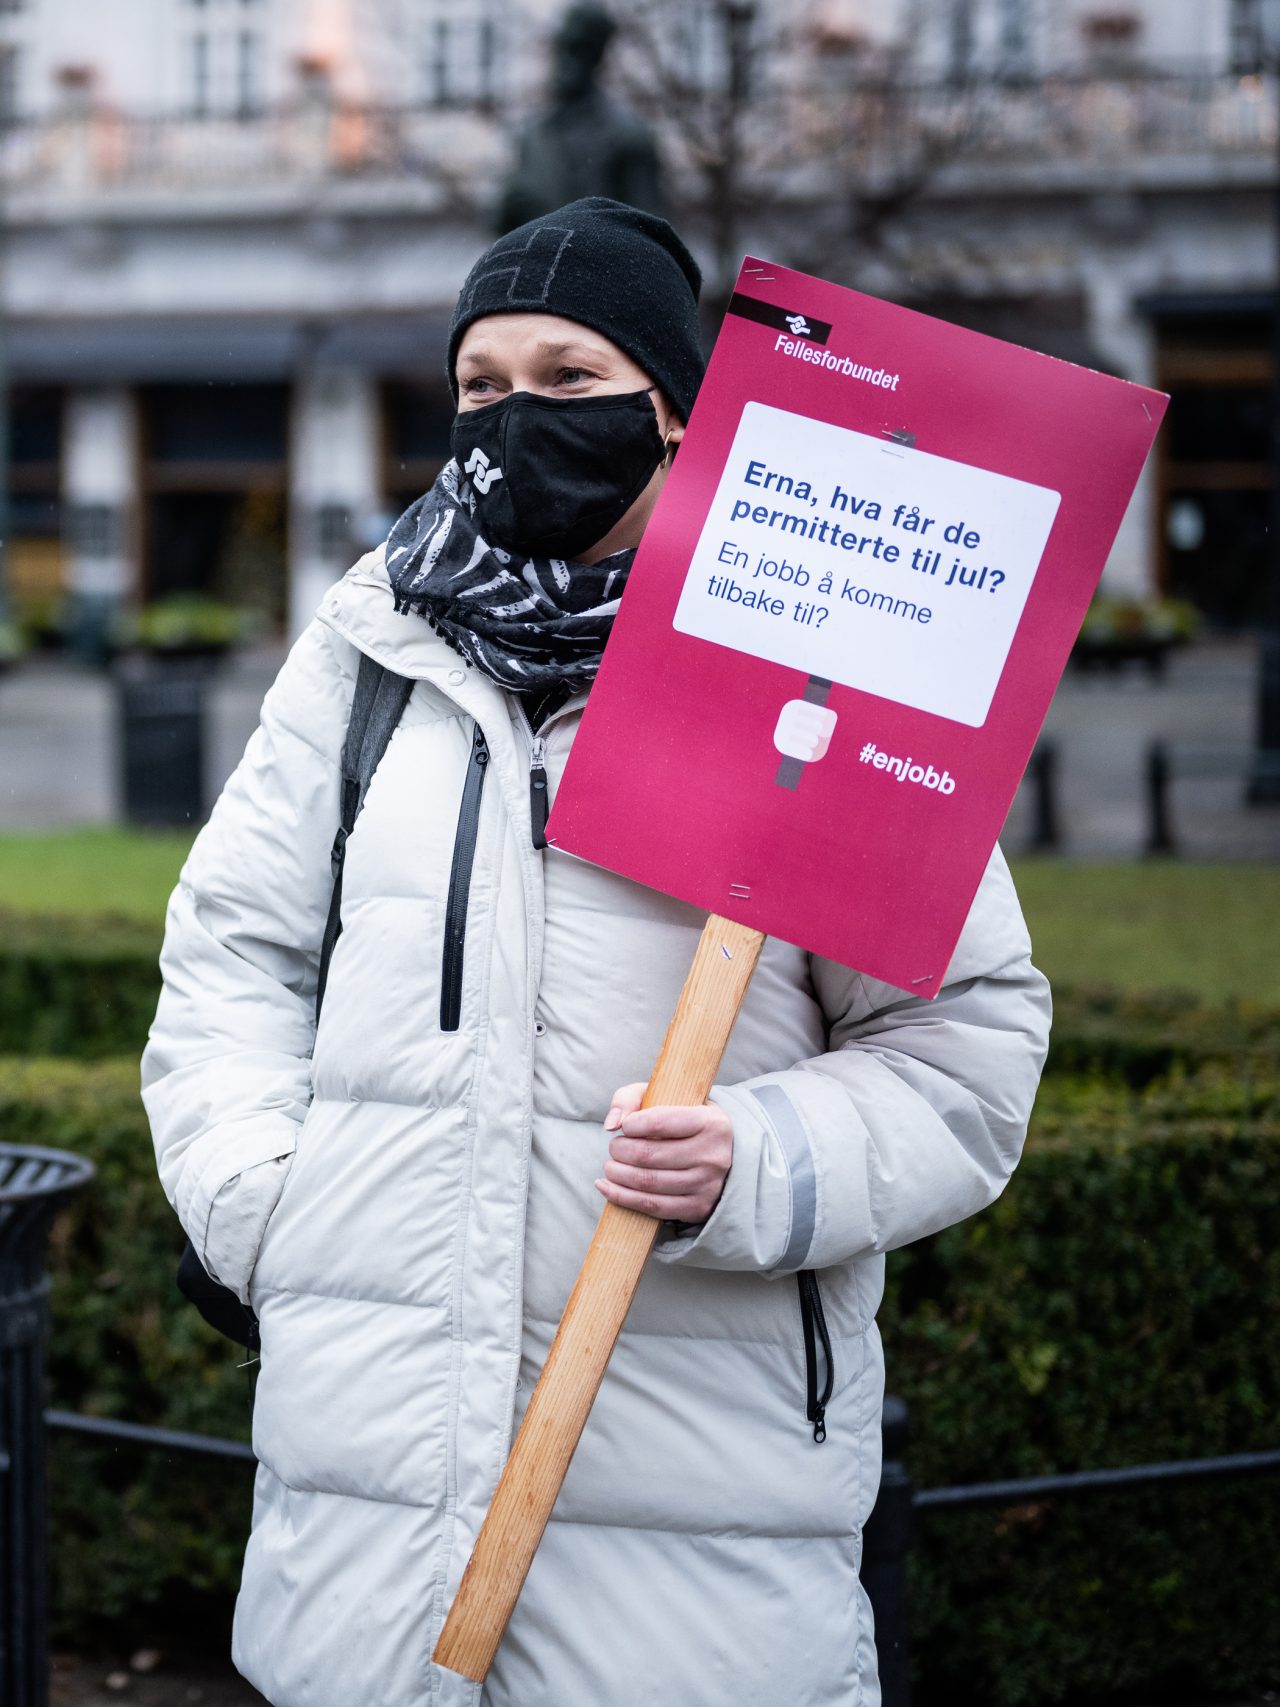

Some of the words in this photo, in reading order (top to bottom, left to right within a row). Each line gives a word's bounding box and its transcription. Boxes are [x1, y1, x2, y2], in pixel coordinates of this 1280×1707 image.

[774, 334, 900, 392] Fellesforbundet
[743, 460, 818, 507] Erna,
[829, 485, 882, 521] hva
[892, 503, 936, 535] får
[943, 521, 981, 550] de
[729, 499, 900, 563] permitterte
[911, 547, 942, 576] til
[945, 557, 1006, 594] jul?
[706, 575, 785, 616] tilbake
[793, 601, 829, 628] til?
[717, 541, 749, 569] En
[753, 552, 810, 587] jobb
[817, 570, 833, 595] å
[840, 578, 932, 624] komme
[859, 742, 956, 795] #enjobb
